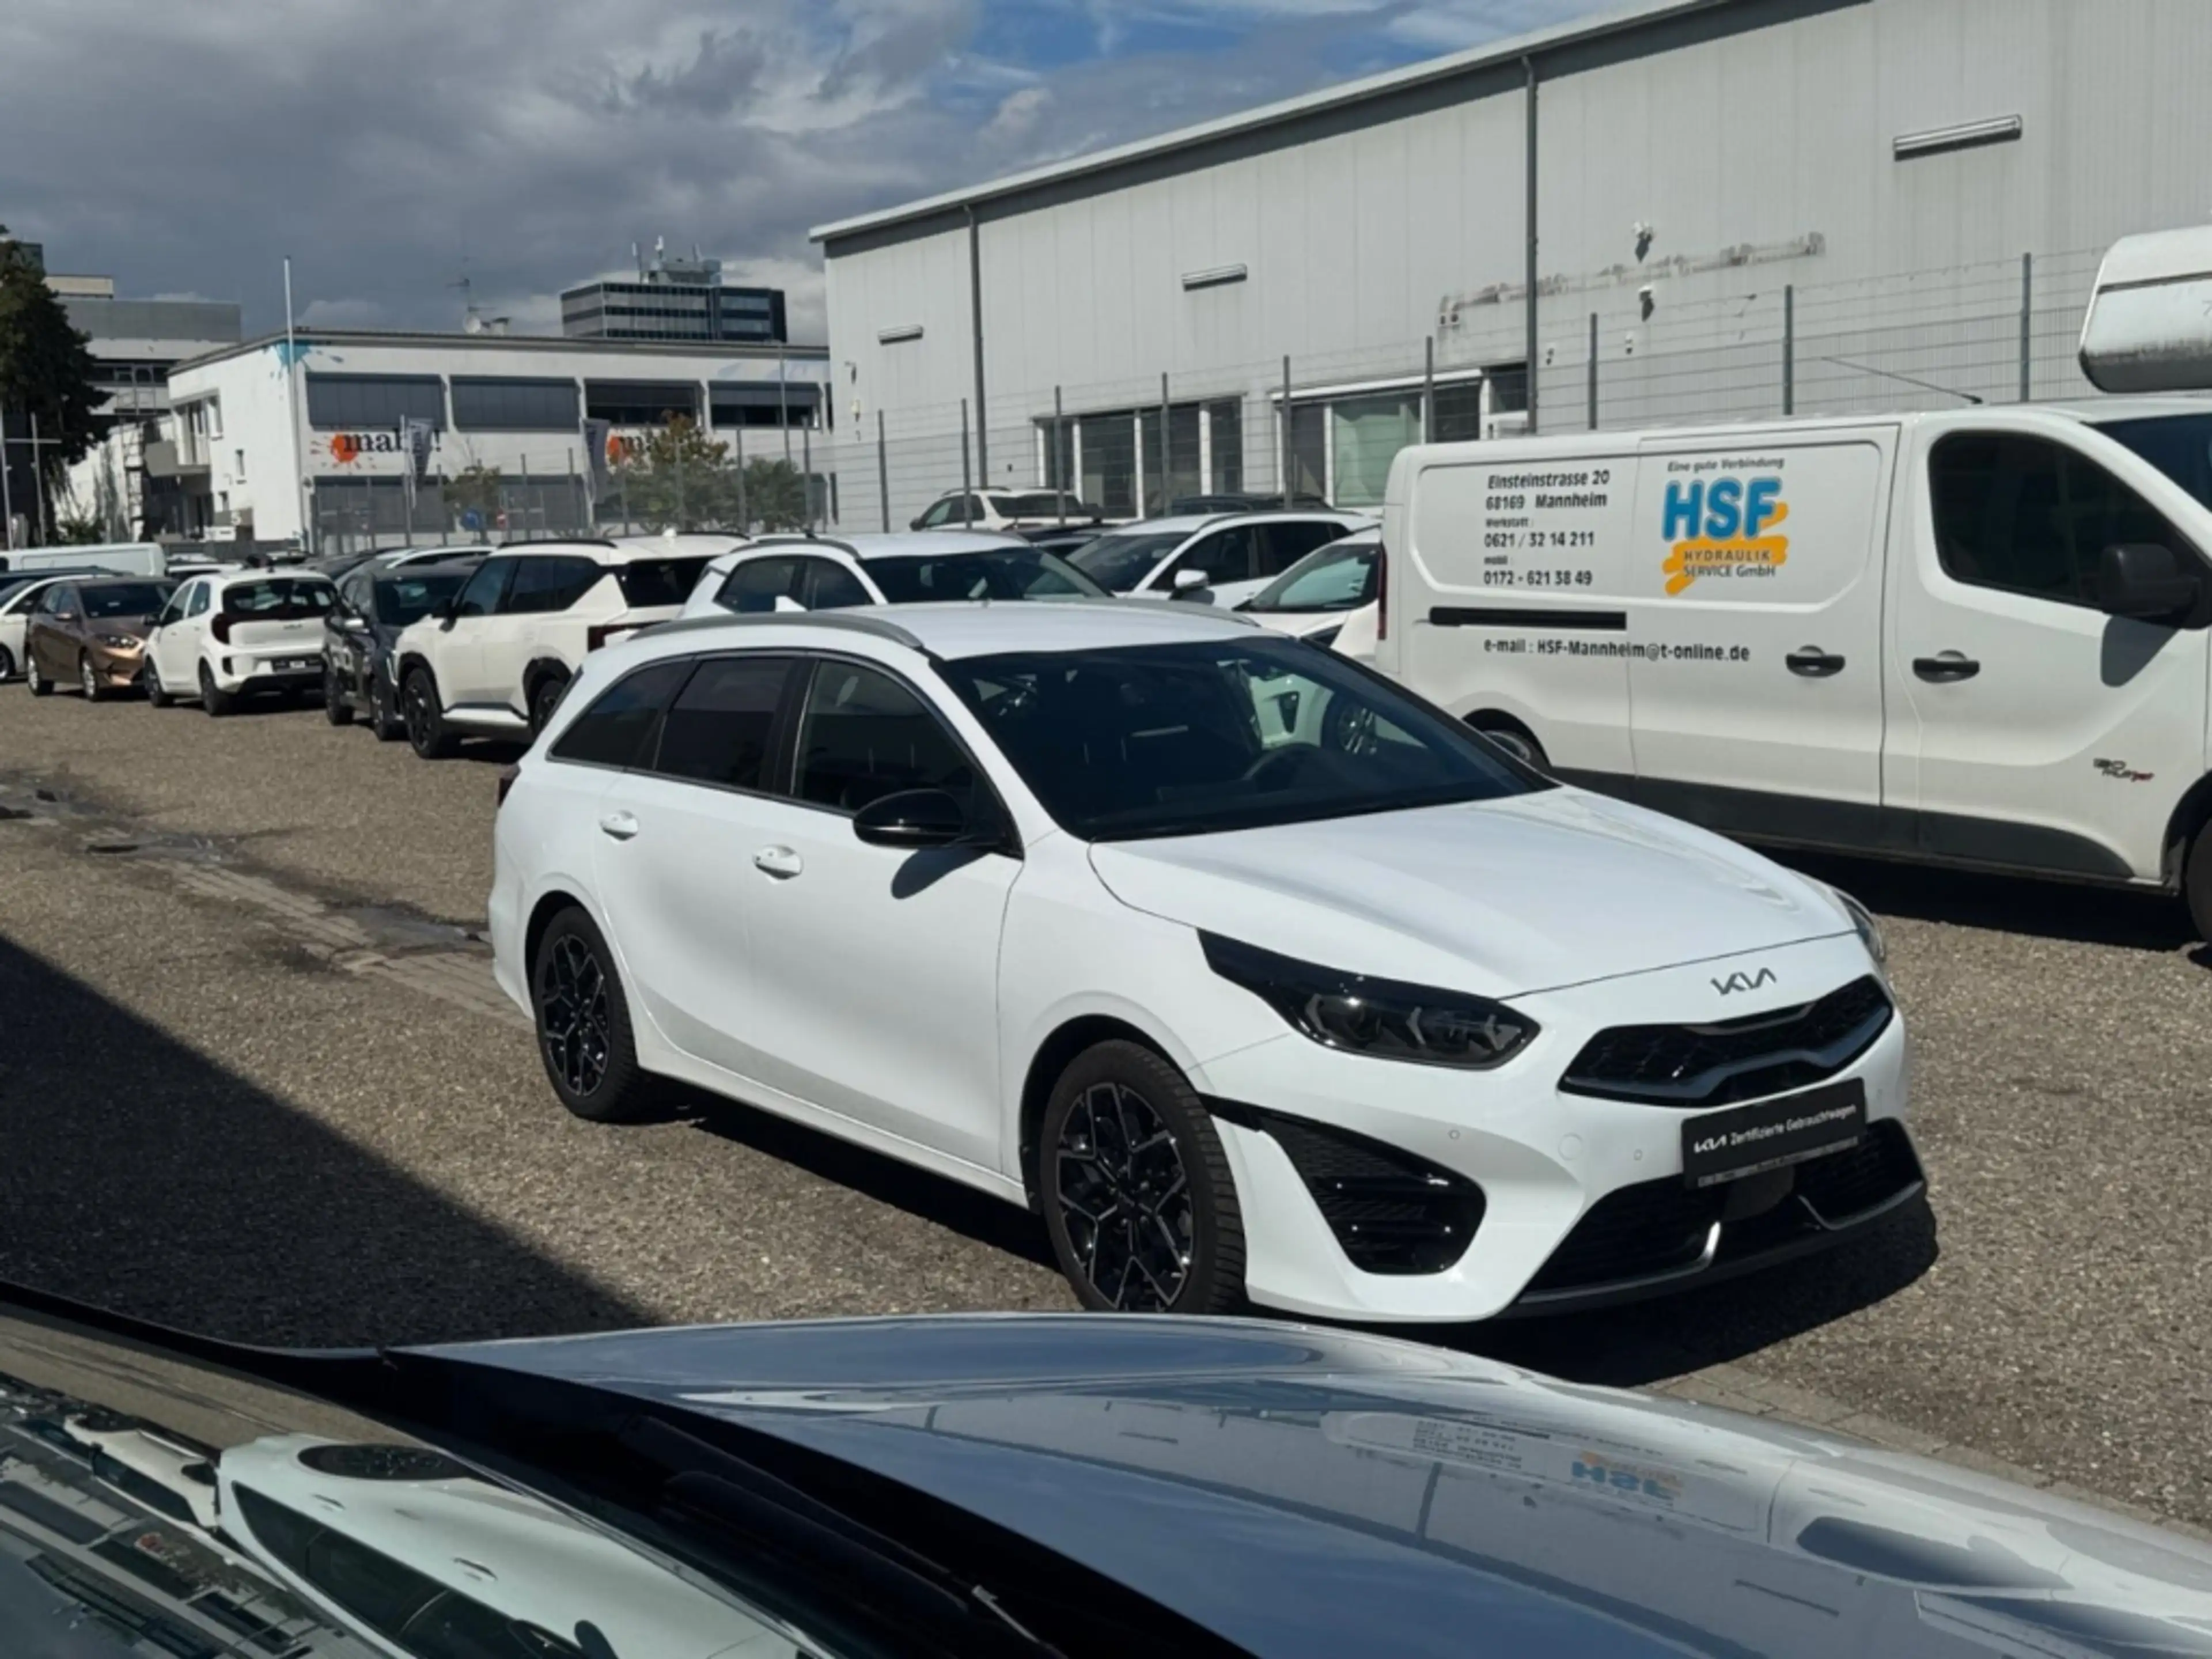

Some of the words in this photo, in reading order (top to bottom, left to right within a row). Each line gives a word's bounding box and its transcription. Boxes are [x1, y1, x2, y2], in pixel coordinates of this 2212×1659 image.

[1668, 461, 1690, 473] Eine
[1694, 461, 1718, 474] gute
[1721, 457, 1785, 470] Verbindung
[1488, 472, 1589, 490] Einsteinstrasse
[1592, 468, 1611, 486] 20
[1486, 494, 1525, 511] 68169
[1535, 491, 1608, 509] Mannheim
[1662, 476, 1783, 540] HSF
[1484, 532, 1516, 548] 0621
[1528, 531, 1546, 547] 32
[1550, 531, 1566, 547] 14
[1569, 530, 1594, 547] 211
[1684, 549, 1771, 562] HYDRAULIK
[1483, 569, 1514, 585] 0172
[1527, 569, 1551, 586] 621
[1554, 569, 1571, 586] 38
[1574, 569, 1593, 586] 49
[1683, 564, 1732, 578] SERVICE
[1736, 563, 1776, 578] GmbH
[1483, 638, 1527, 654] e-mail
[1537, 639, 1751, 662] HSF-Mannheim@t-online.de
[1710, 967, 1778, 995] KIA
[1694, 1134, 1727, 1154] KIA
